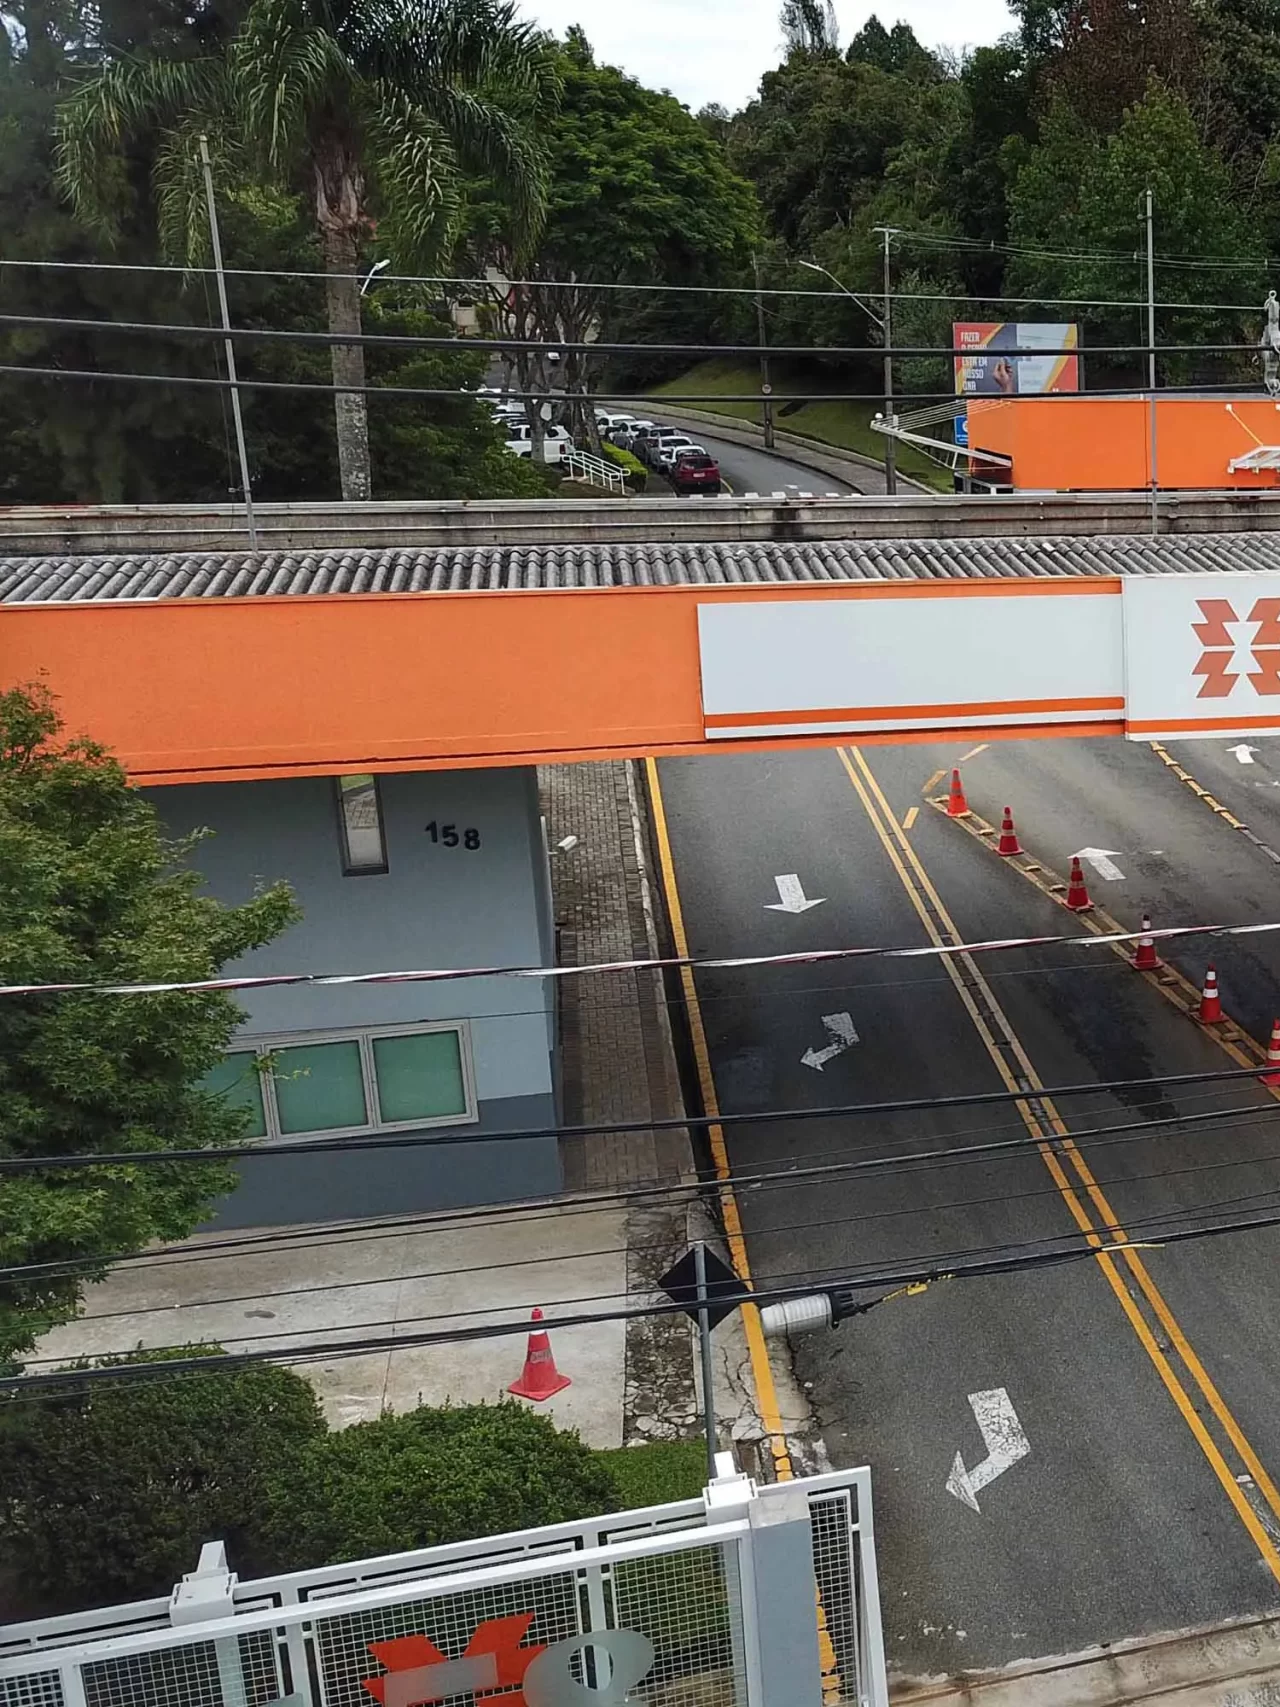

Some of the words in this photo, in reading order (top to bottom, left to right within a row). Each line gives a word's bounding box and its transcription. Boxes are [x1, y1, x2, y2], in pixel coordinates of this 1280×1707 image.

[960, 332, 980, 342] FAZER
[963, 368, 984, 379] NOSSO
[424, 820, 481, 850] 158
